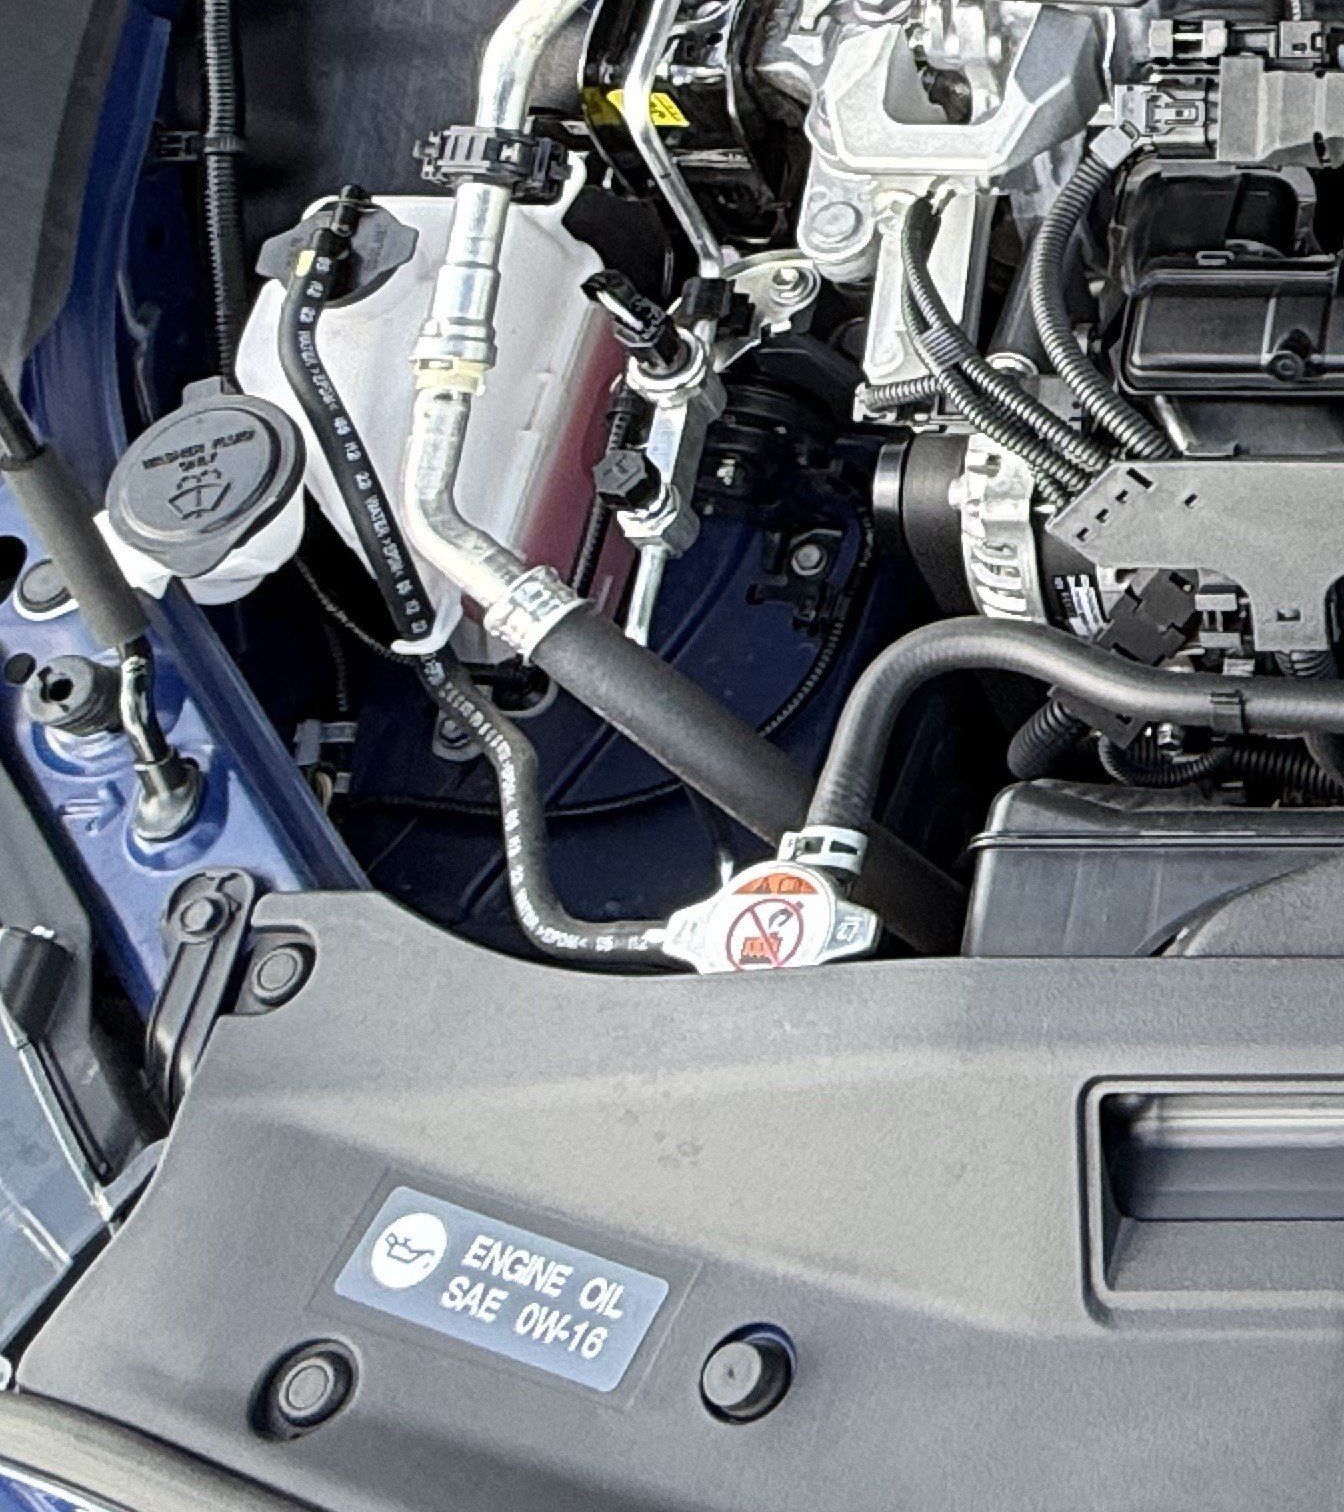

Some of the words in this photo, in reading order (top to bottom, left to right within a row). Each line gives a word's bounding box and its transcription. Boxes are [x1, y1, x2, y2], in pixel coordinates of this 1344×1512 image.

[439, 1275, 510, 1324] SAE
[513, 1302, 609, 1360] 0W-16
[460, 1234, 574, 1299] ENGINE
[577, 1276, 626, 1320] OIL
